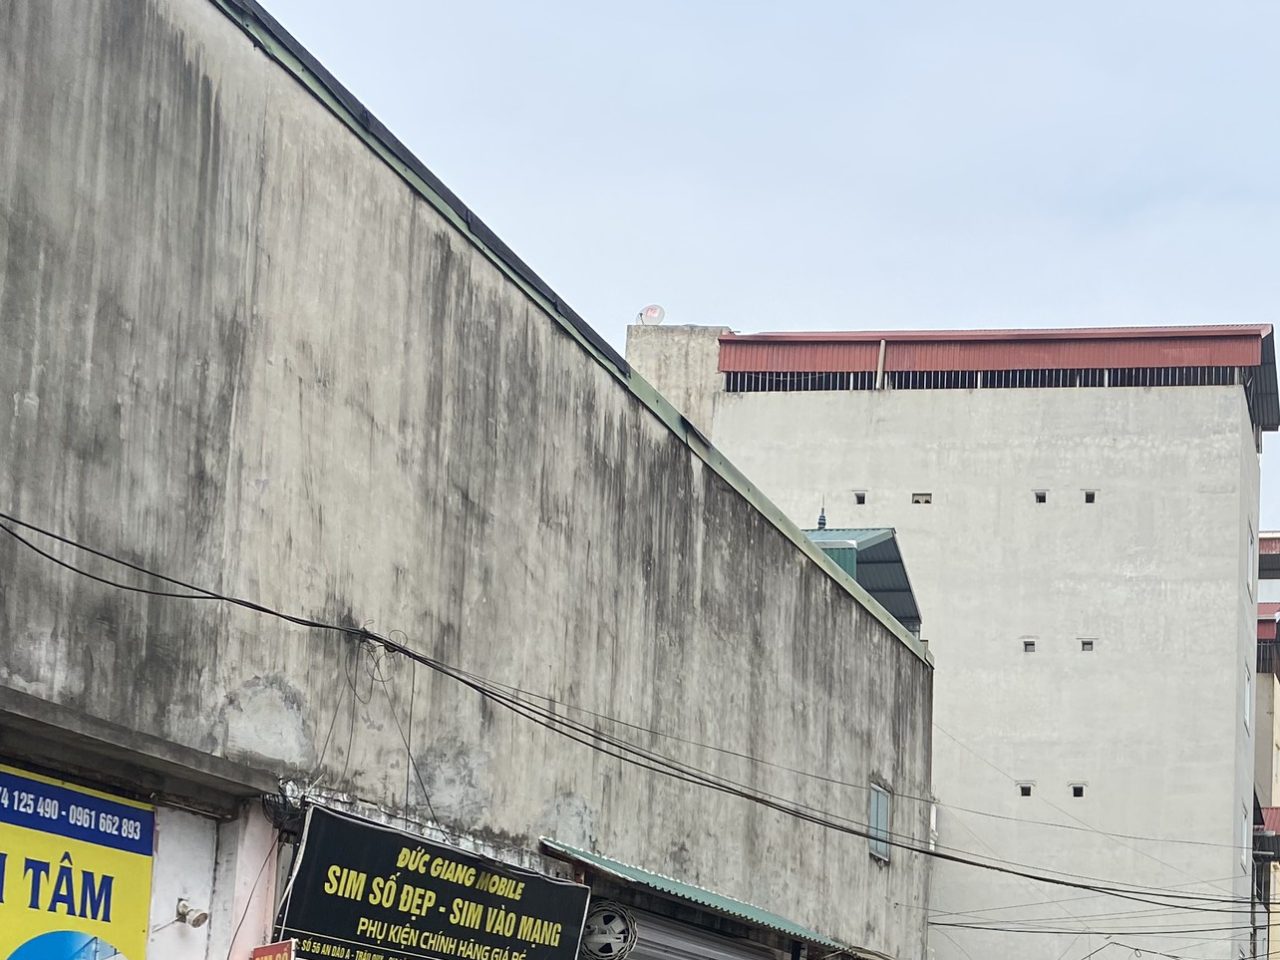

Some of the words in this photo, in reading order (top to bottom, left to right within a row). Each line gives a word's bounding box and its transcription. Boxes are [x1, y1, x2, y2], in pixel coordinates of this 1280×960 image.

[13, 790, 34, 814] 125
[37, 797, 59, 820] 490
[69, 804, 96, 830] 0961
[99, 812, 119, 836] 662
[121, 818, 141, 840] 893
[23, 851, 115, 923] TÂM
[396, 846, 430, 874] ĐỨC
[430, 857, 476, 887] GIANG
[475, 871, 525, 900] MOBILE
[324, 864, 367, 902] SIM
[368, 872, 400, 909] SỐ
[398, 884, 437, 921] ĐẸP
[449, 898, 484, 930] SIM
[485, 904, 516, 938] VÀO
[517, 915, 562, 948] MẠNG
[301, 937, 312, 952] SỐ
[357, 917, 388, 945] PHỤ
[387, 923, 420, 949] KIỆN
[420, 931, 458, 956] CHÍNH
